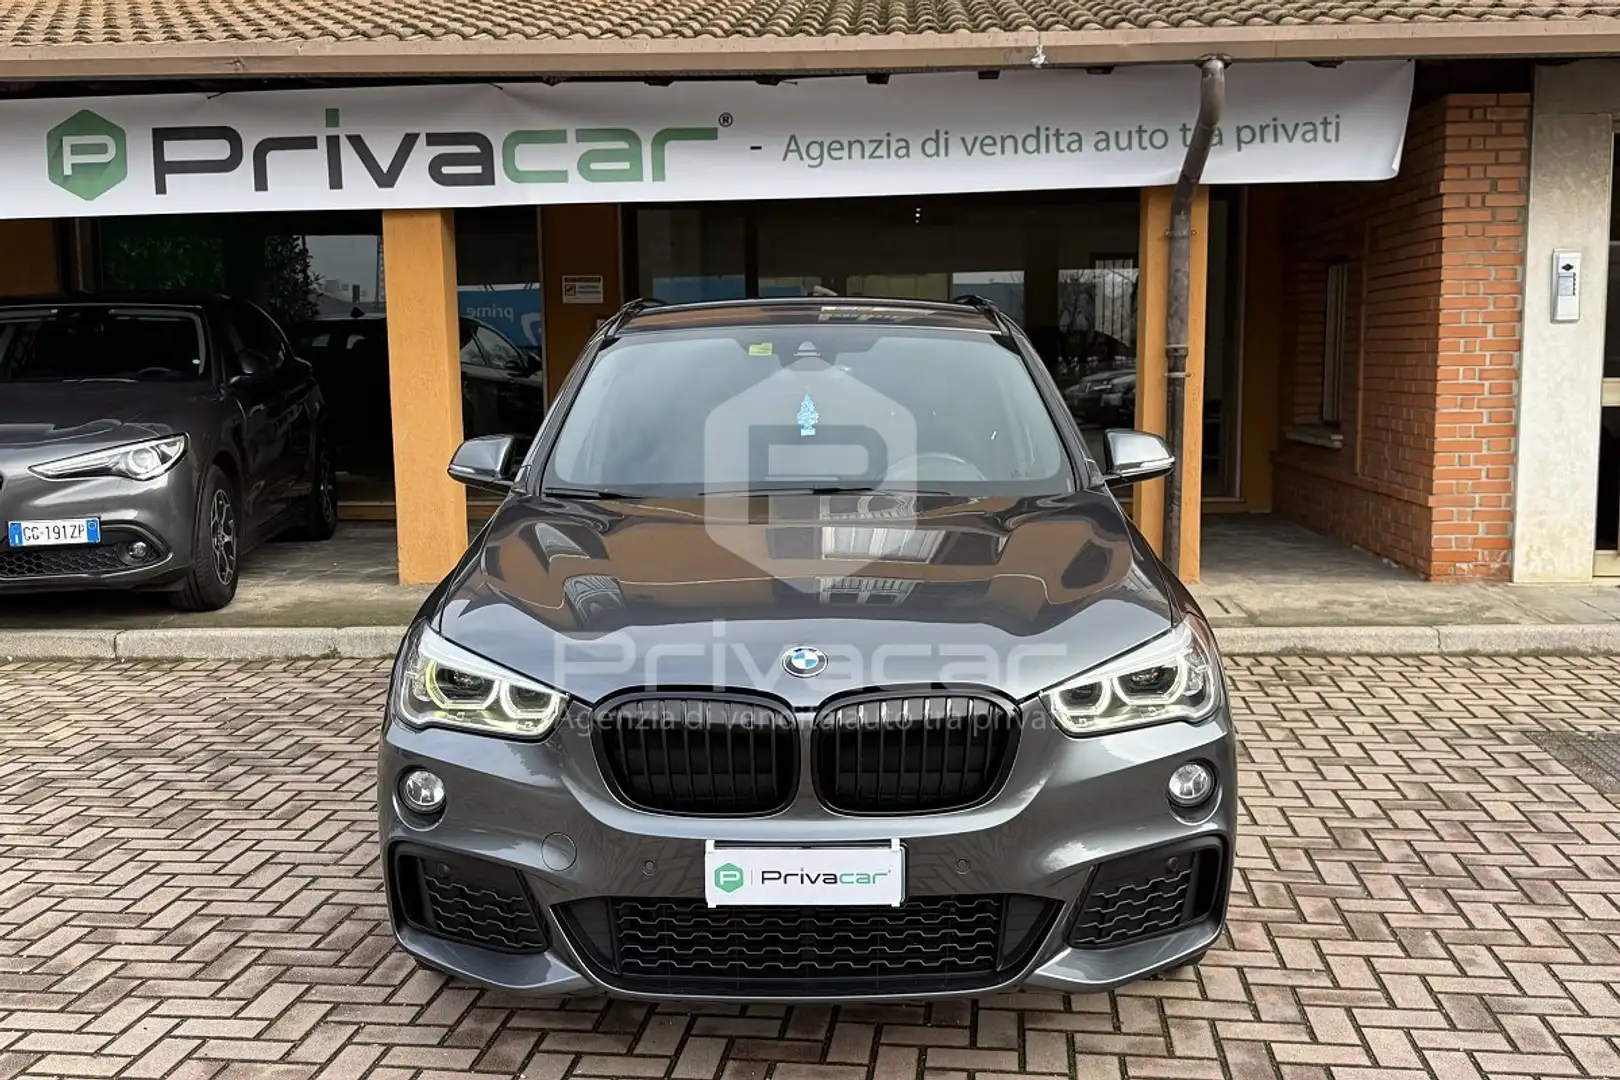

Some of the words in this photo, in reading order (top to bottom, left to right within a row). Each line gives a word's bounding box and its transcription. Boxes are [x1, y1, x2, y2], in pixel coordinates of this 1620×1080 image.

[782, 132, 911, 168] Agenzia
[921, 129, 950, 158] di
[960, 125, 1083, 157] vendita
[1093, 124, 1169, 152] auto
[1179, 122, 1224, 149] ta
[1236, 114, 1341, 152] privati
